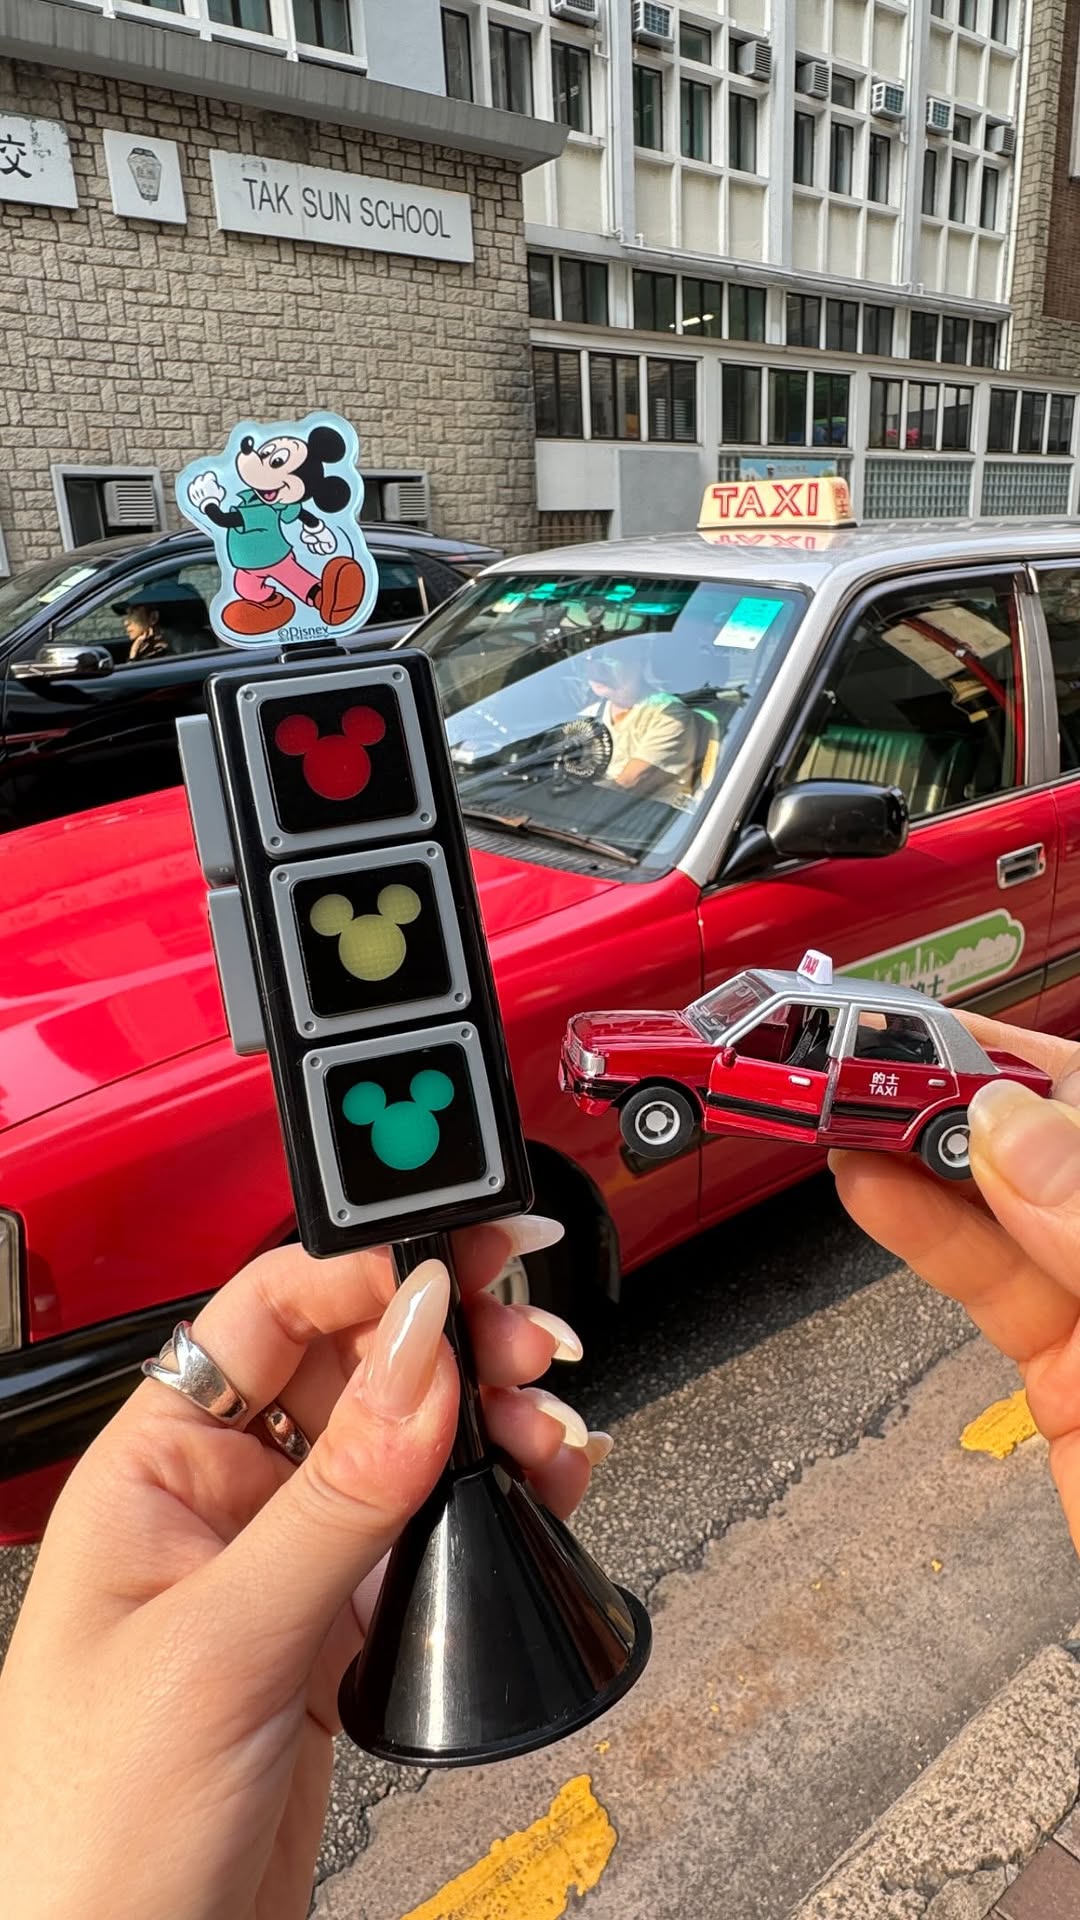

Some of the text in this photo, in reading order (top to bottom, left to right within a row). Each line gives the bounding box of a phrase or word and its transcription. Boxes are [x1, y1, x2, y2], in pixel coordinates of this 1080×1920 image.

[242, 177, 451, 239] TAK SUN SCHOOL
[712, 482, 819, 518] TAXI
[801, 954, 820, 976] TAXI
[871, 1071, 900, 1086] 的士
[868, 1083, 898, 1097] TAXI
